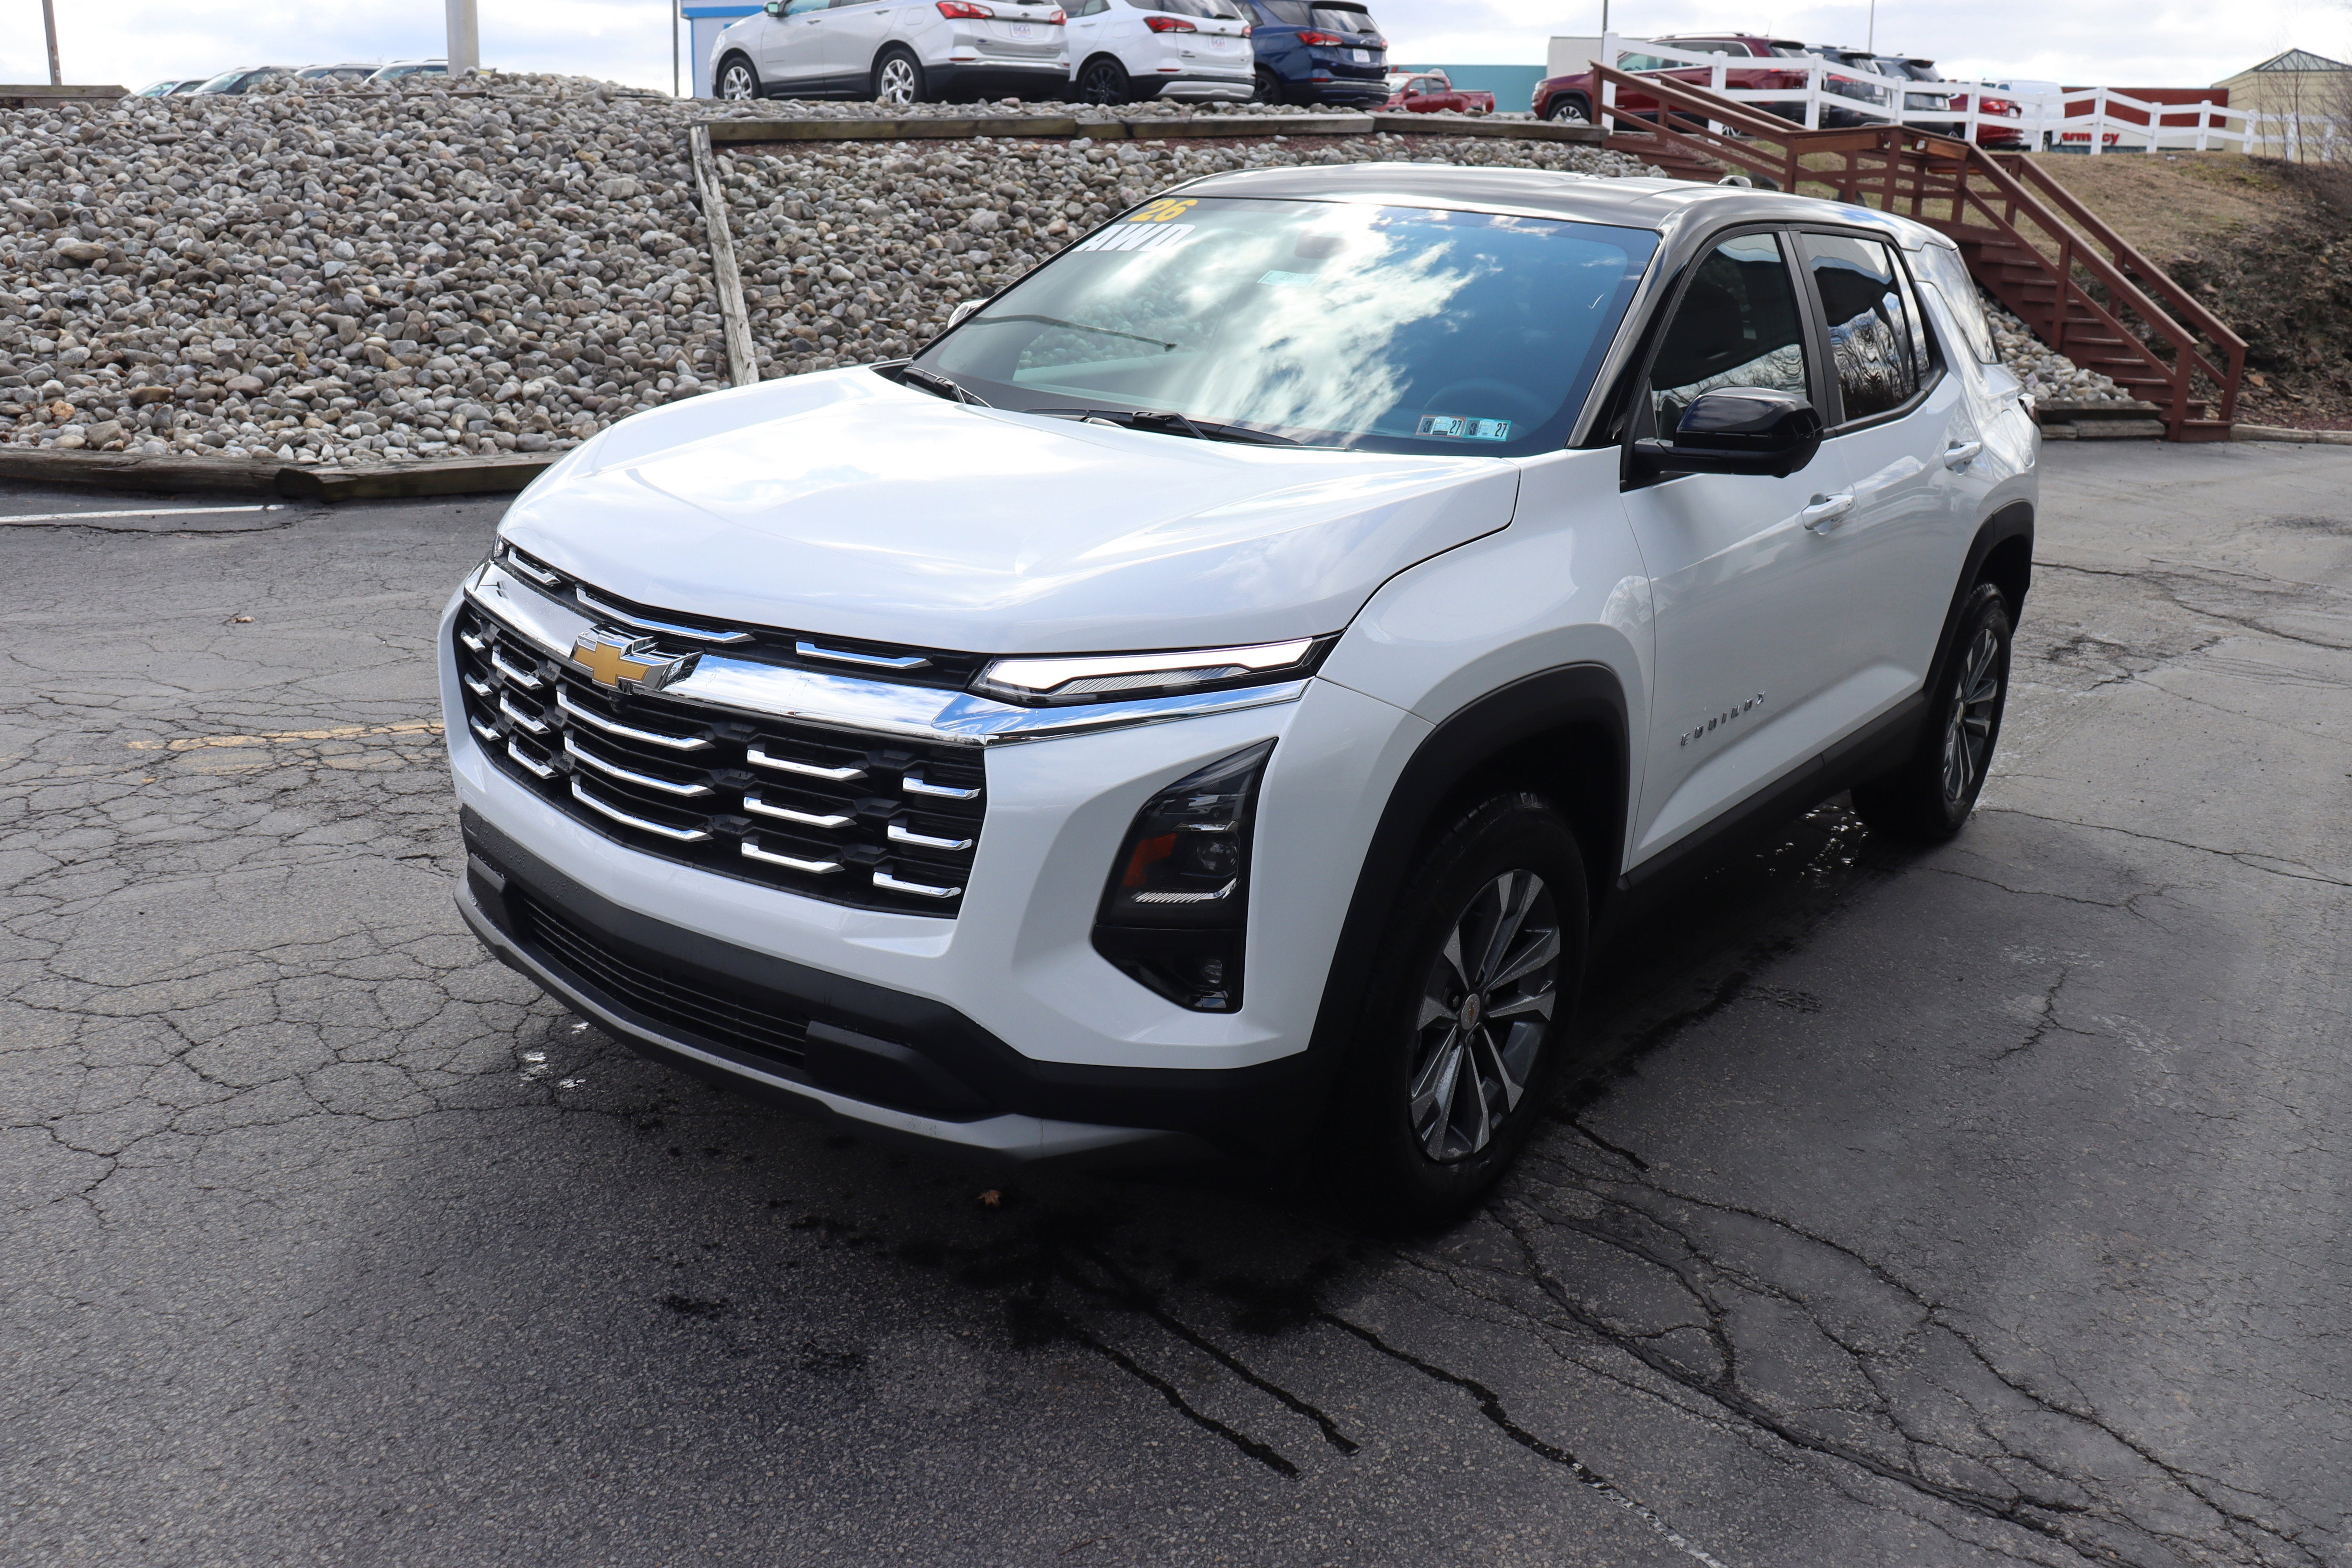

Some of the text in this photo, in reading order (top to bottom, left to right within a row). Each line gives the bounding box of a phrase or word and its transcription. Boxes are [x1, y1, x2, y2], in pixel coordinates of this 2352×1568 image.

[1071, 223, 1196, 252] AWD
[1423, 420, 1462, 435] 3 27
[1469, 423, 1508, 437] 3 27
